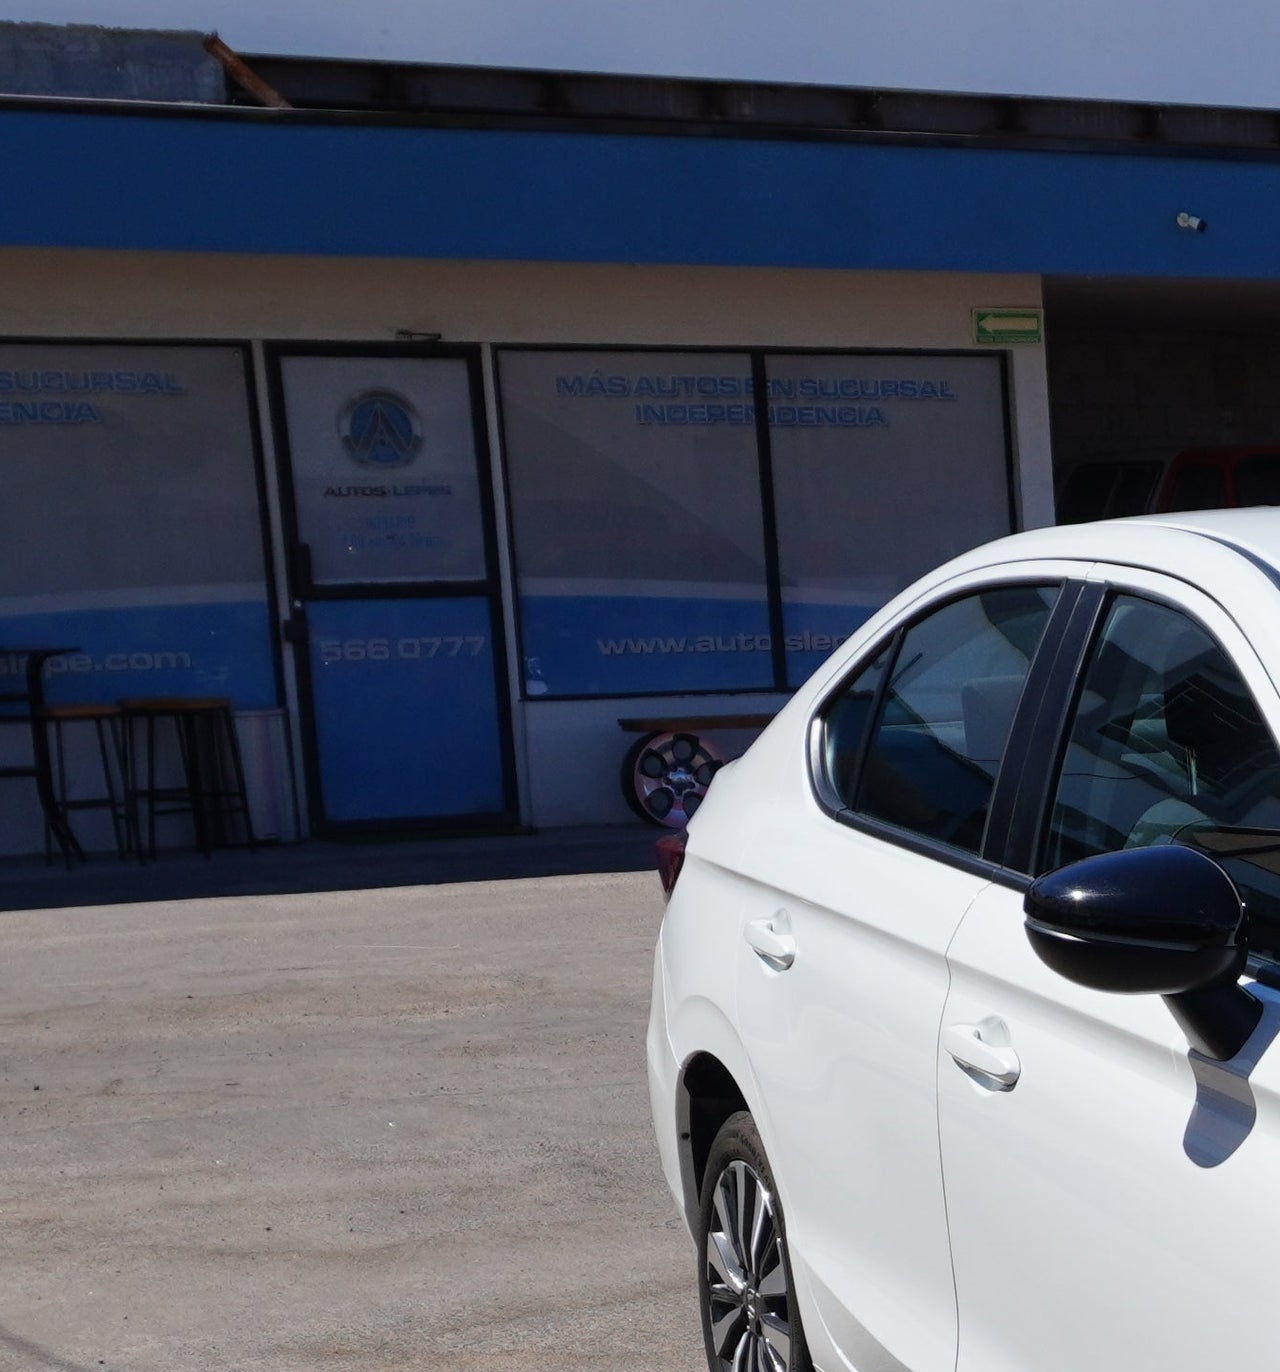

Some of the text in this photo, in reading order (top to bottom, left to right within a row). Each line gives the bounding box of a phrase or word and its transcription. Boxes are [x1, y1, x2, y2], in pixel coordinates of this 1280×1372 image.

[633, 376, 738, 398] AUTOS
[799, 377, 956, 401] SUCURSAL
[319, 635, 486, 663] 566 0777
